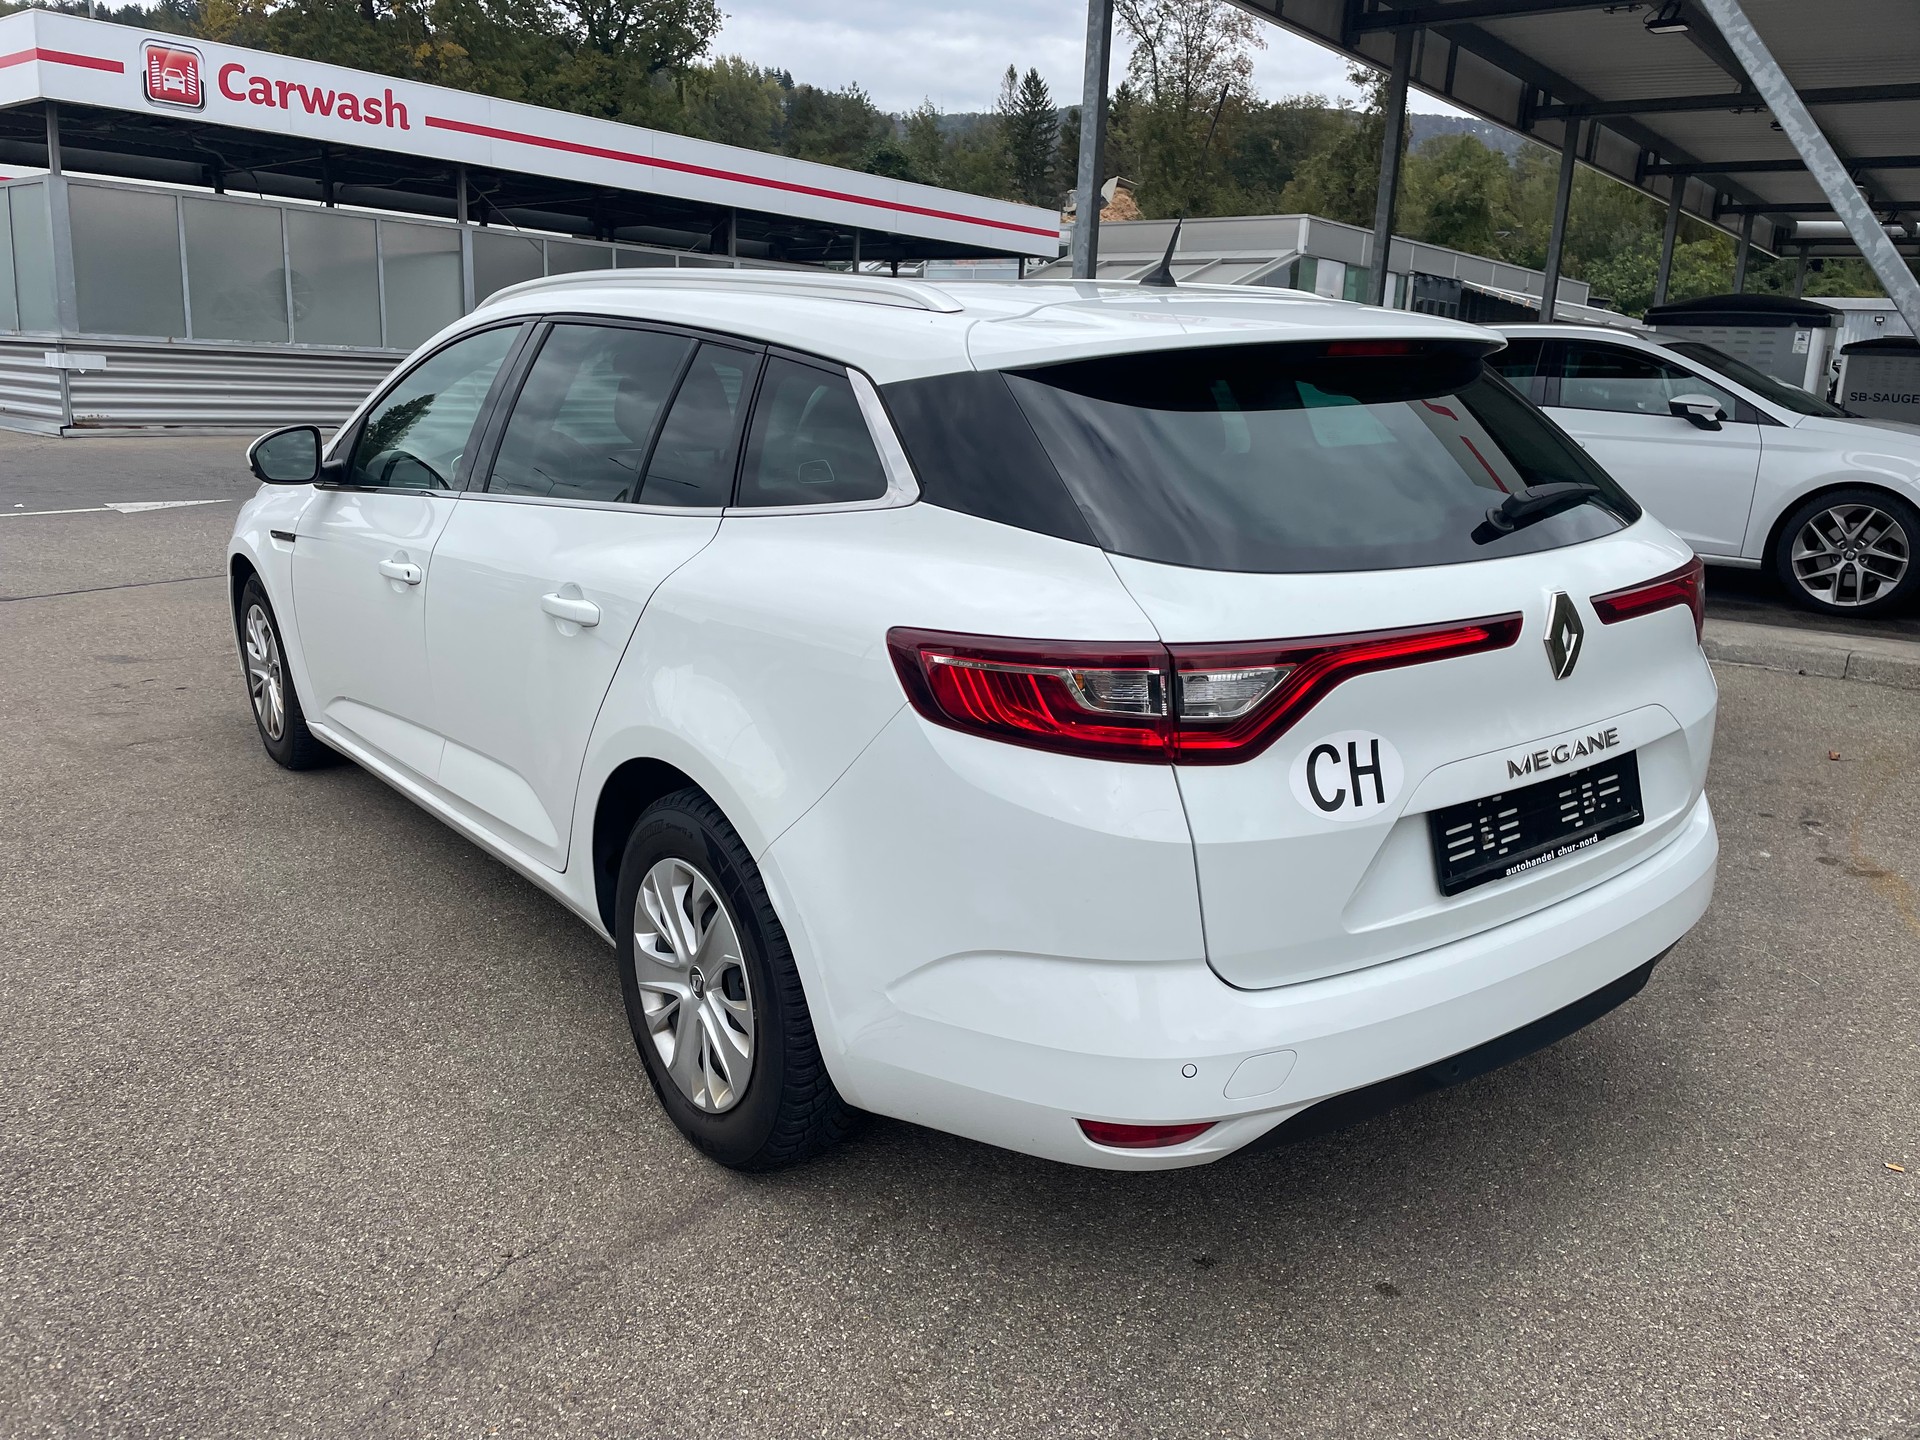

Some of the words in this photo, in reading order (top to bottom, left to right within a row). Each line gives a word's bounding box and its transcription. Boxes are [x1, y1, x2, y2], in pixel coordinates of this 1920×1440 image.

[218, 63, 411, 130] Carwash
[1849, 391, 1920, 404] SB-SAUGE
[1306, 738, 1386, 812] CH
[1506, 727, 1620, 779] MEGANE
[1505, 850, 1555, 876] autohandel
[1557, 833, 1599, 857] chur-nord
